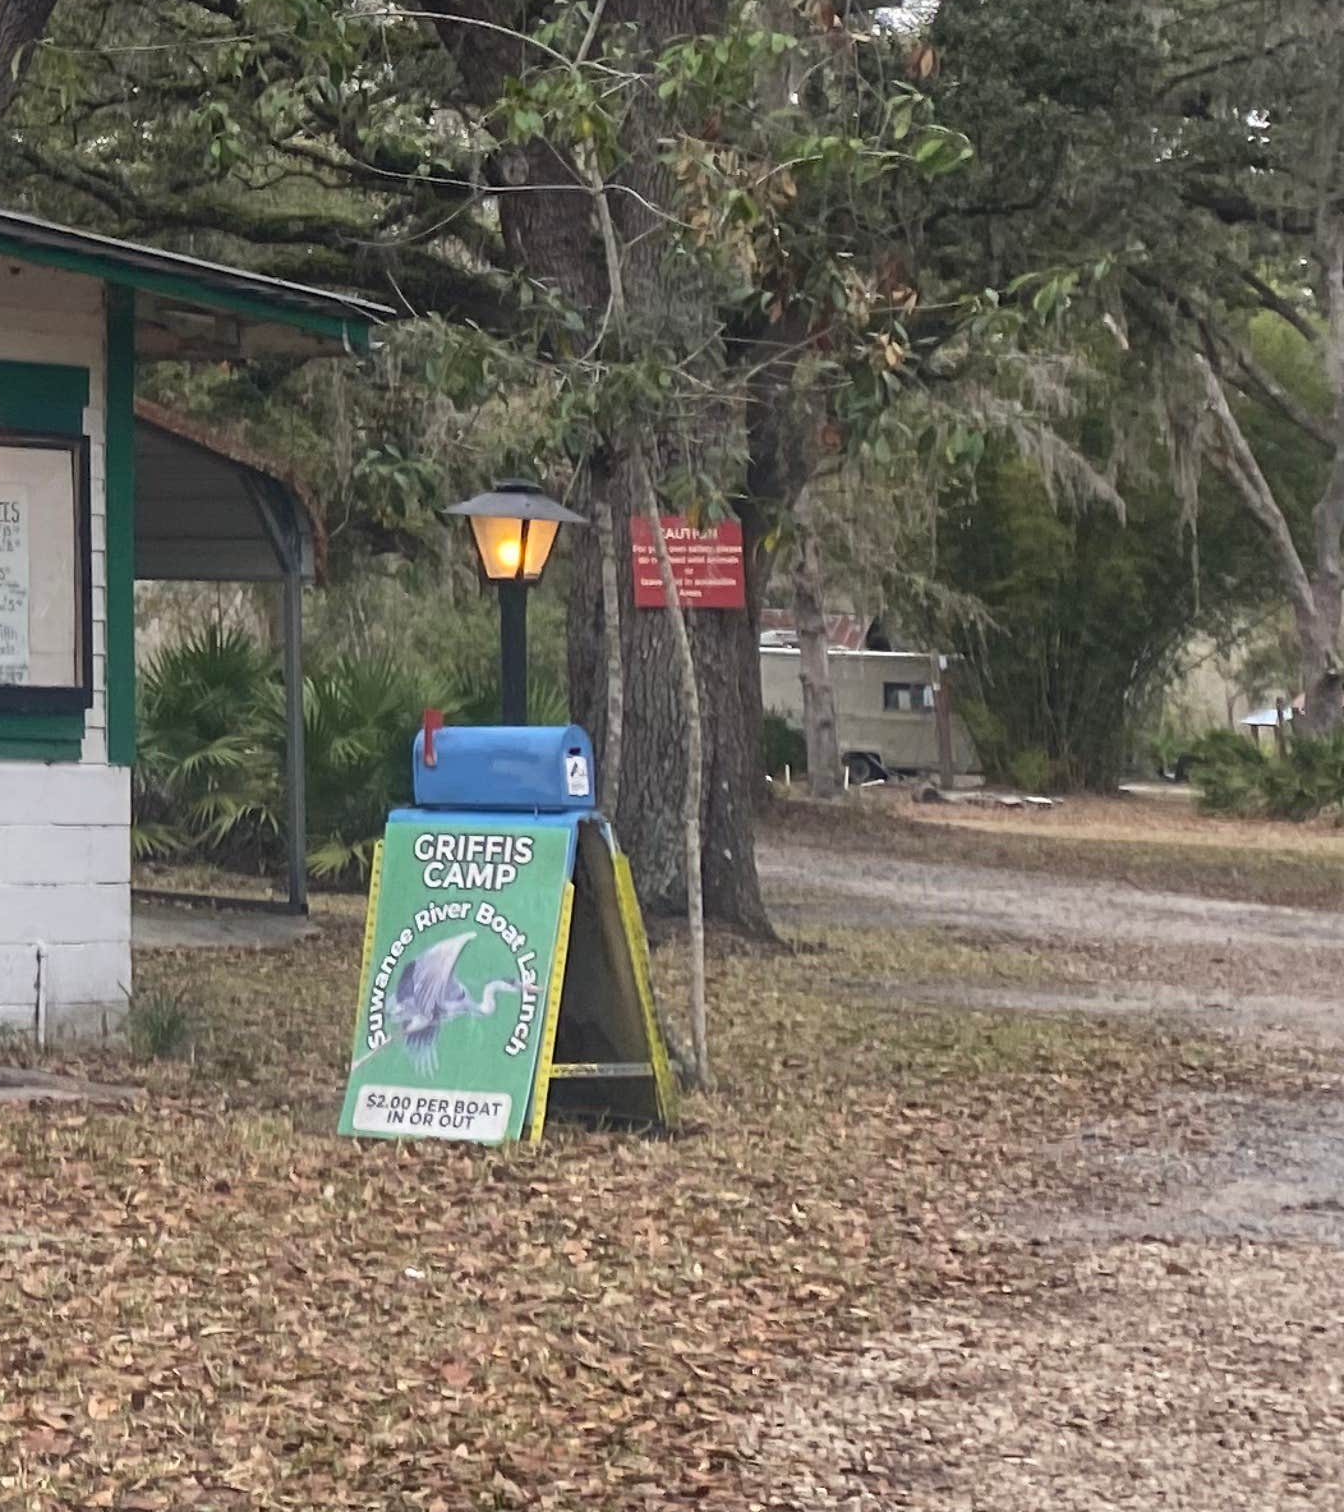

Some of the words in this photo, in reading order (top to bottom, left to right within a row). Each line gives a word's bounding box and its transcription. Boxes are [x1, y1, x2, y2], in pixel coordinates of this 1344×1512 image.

[660, 527, 719, 540] AUTION
[413, 833, 534, 864] GRIFFIS
[423, 861, 518, 890] CAMP
[414, 902, 472, 932] River
[475, 901, 527, 952] Boat
[504, 951, 538, 1056] Launch
[366, 1093, 412, 1110] $2.00
[416, 1098, 449, 1114] PER
[454, 1100, 503, 1117] BOAT
[386, 1110, 405, 1124] IN
[409, 1112, 434, 1127] OR
[439, 1114, 475, 1130] OUT
